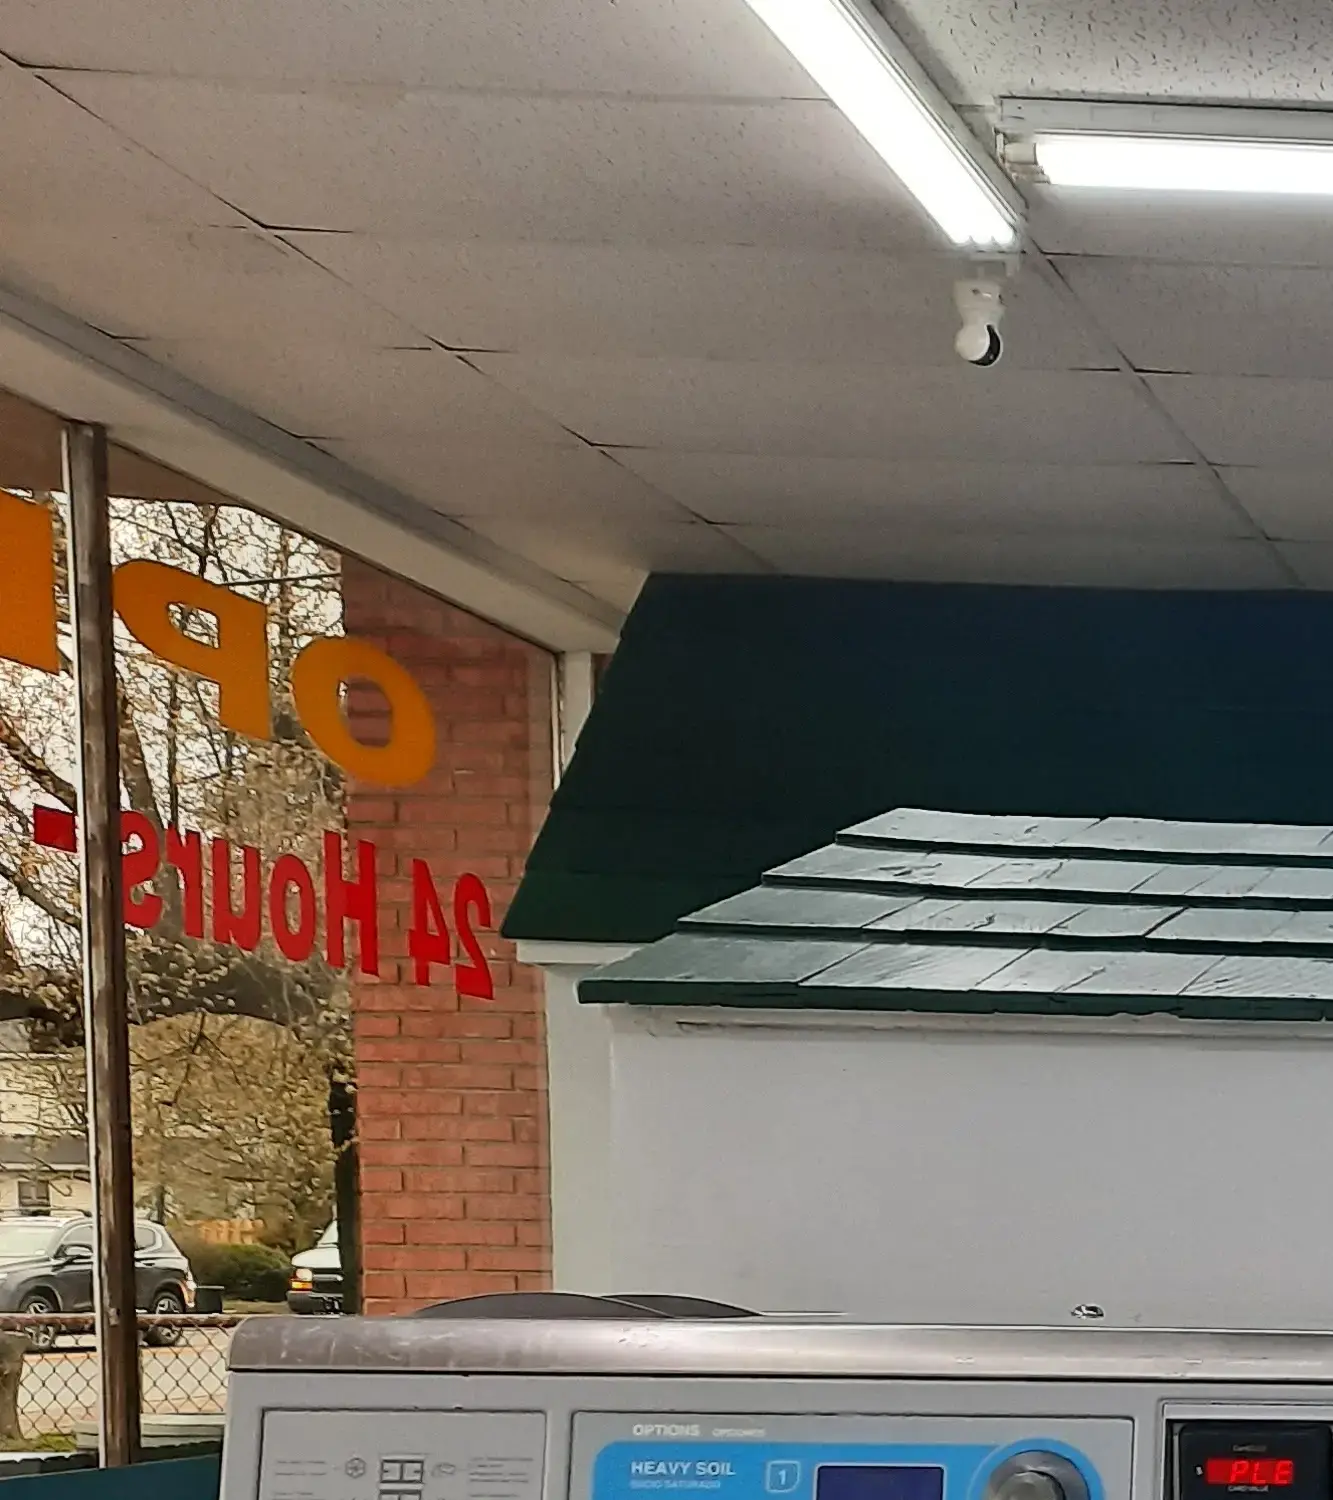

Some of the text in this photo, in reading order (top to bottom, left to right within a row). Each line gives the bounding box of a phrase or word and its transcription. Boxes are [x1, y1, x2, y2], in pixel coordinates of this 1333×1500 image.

[632, 1424, 700, 1437] OPTIONS
[630, 1461, 737, 1475] HEAVY SOIL
[777, 1469, 788, 1486] 1
